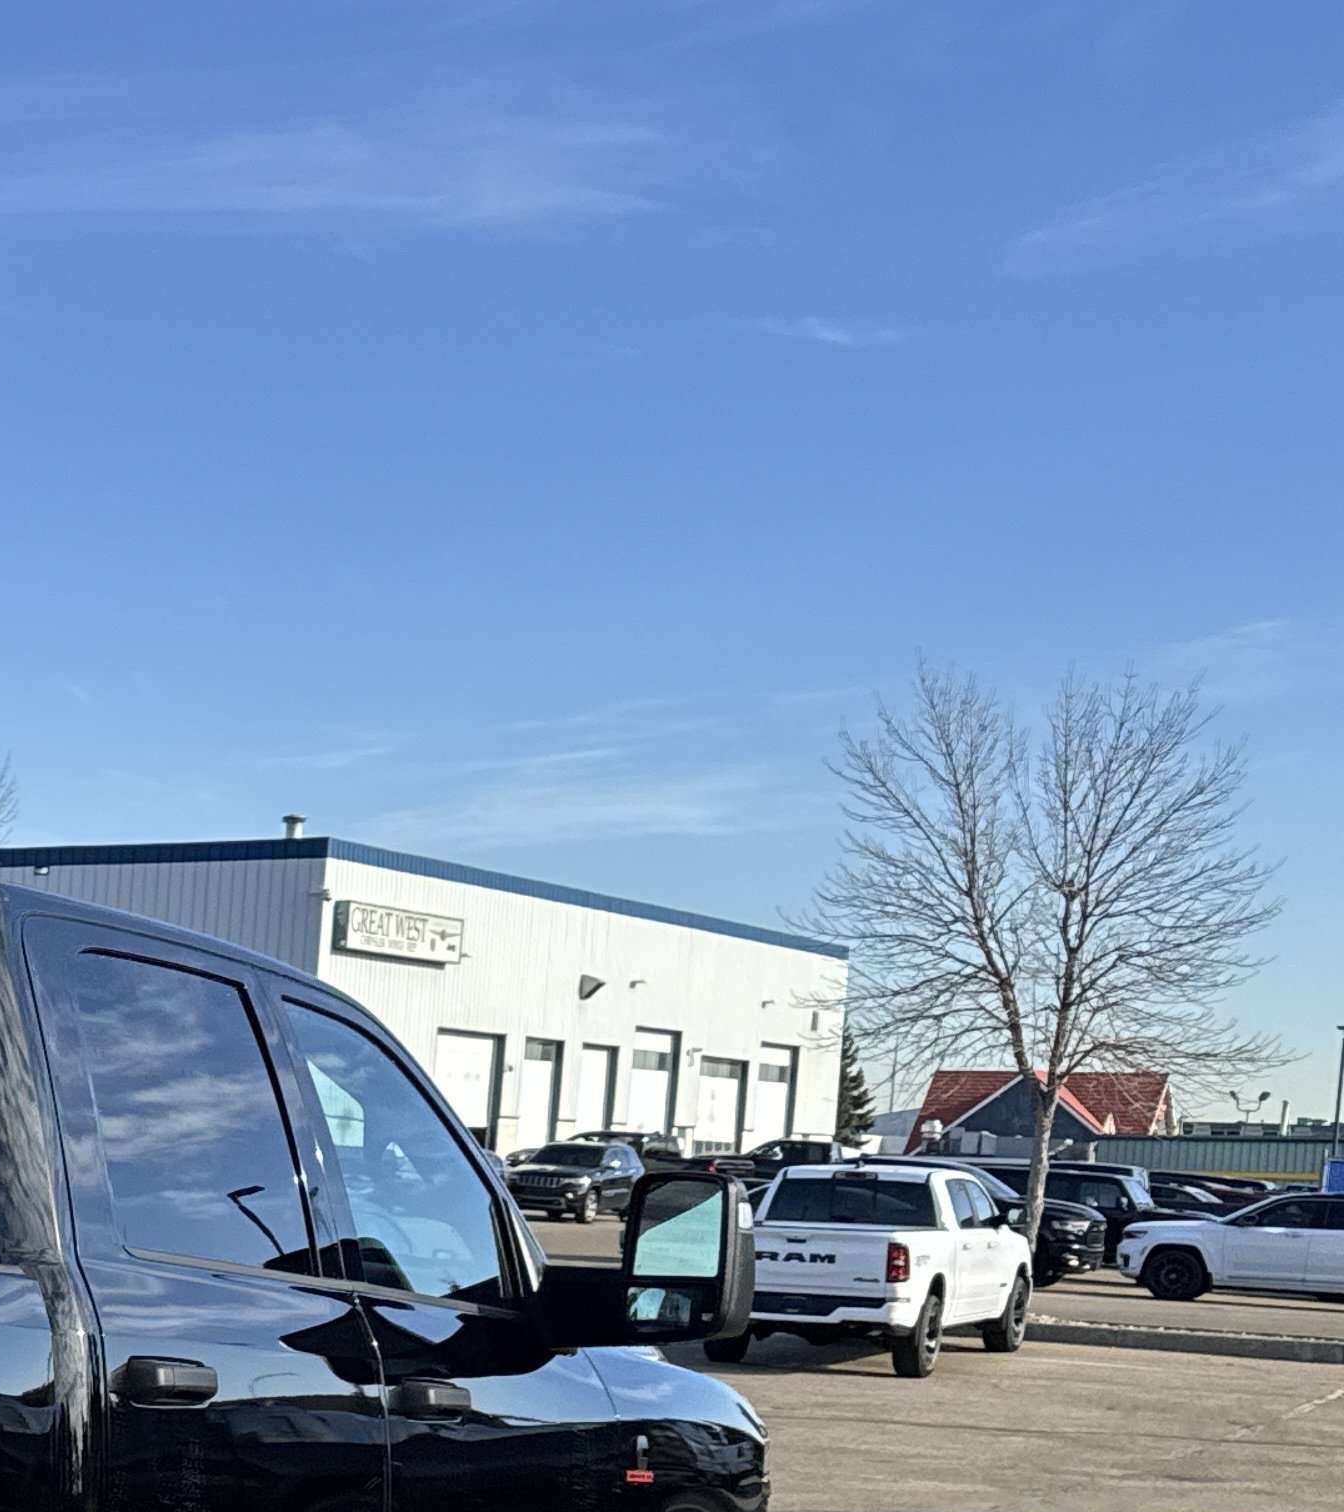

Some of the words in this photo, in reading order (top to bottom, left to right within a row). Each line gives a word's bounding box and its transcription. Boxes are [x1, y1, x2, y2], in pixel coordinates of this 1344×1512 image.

[352, 906, 393, 937] GREAT
[395, 912, 428, 943] WEST
[754, 1251, 836, 1264] RAM
